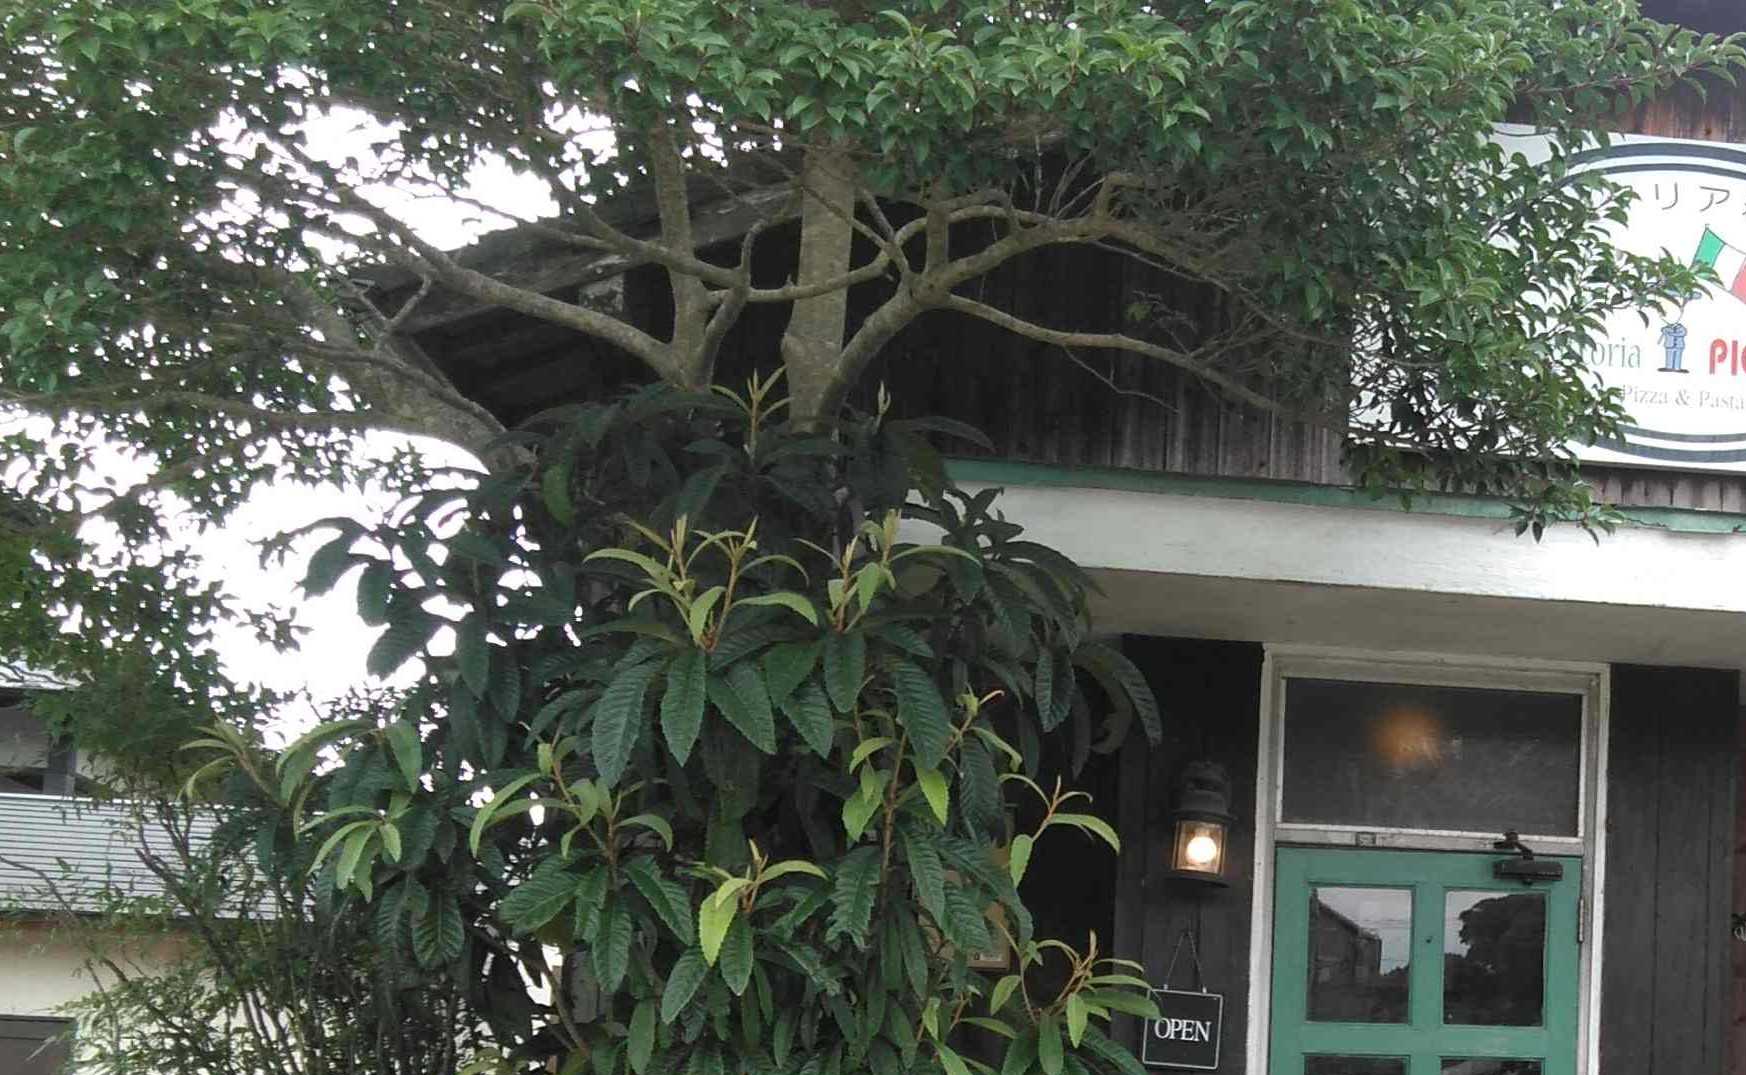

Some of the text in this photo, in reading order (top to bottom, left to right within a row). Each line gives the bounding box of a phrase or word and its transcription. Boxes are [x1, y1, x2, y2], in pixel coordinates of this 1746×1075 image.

[1622, 384, 1745, 411] Pizza & Pasta
[1154, 1016, 1212, 1043] OPEN
